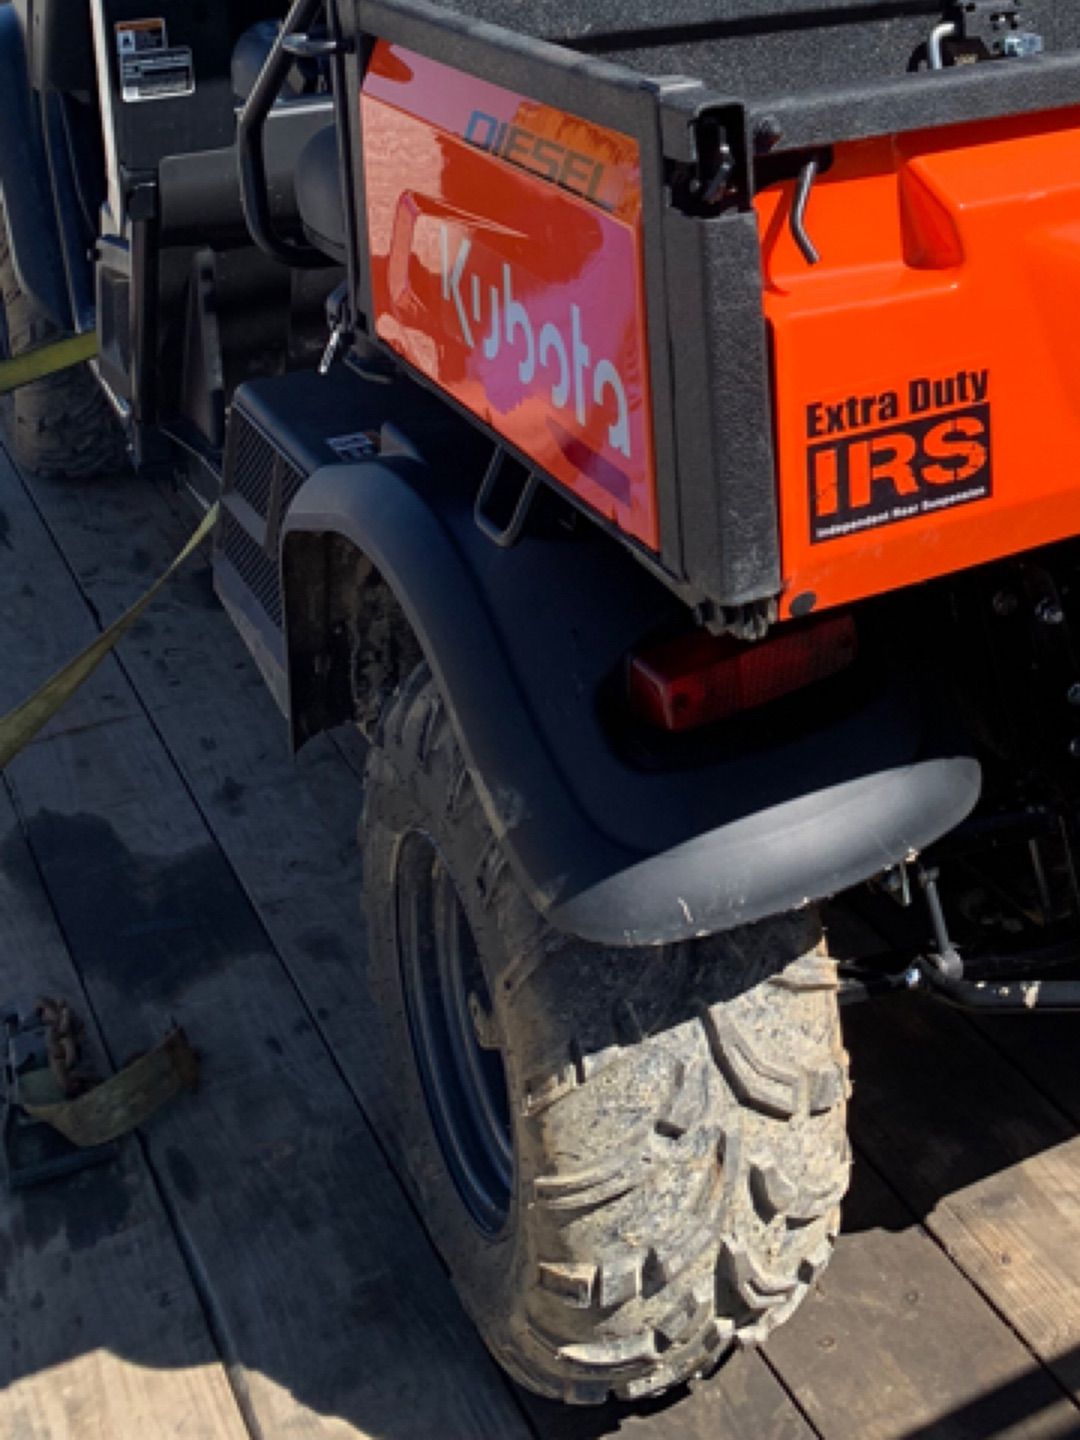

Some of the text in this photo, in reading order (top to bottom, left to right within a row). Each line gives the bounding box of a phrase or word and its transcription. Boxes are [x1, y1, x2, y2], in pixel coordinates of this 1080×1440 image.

[465, 110, 612, 210] DIESEL
[439, 224, 631, 458] Kubota
[806, 370, 989, 438] Extra Duty
[815, 416, 988, 516] IRS
